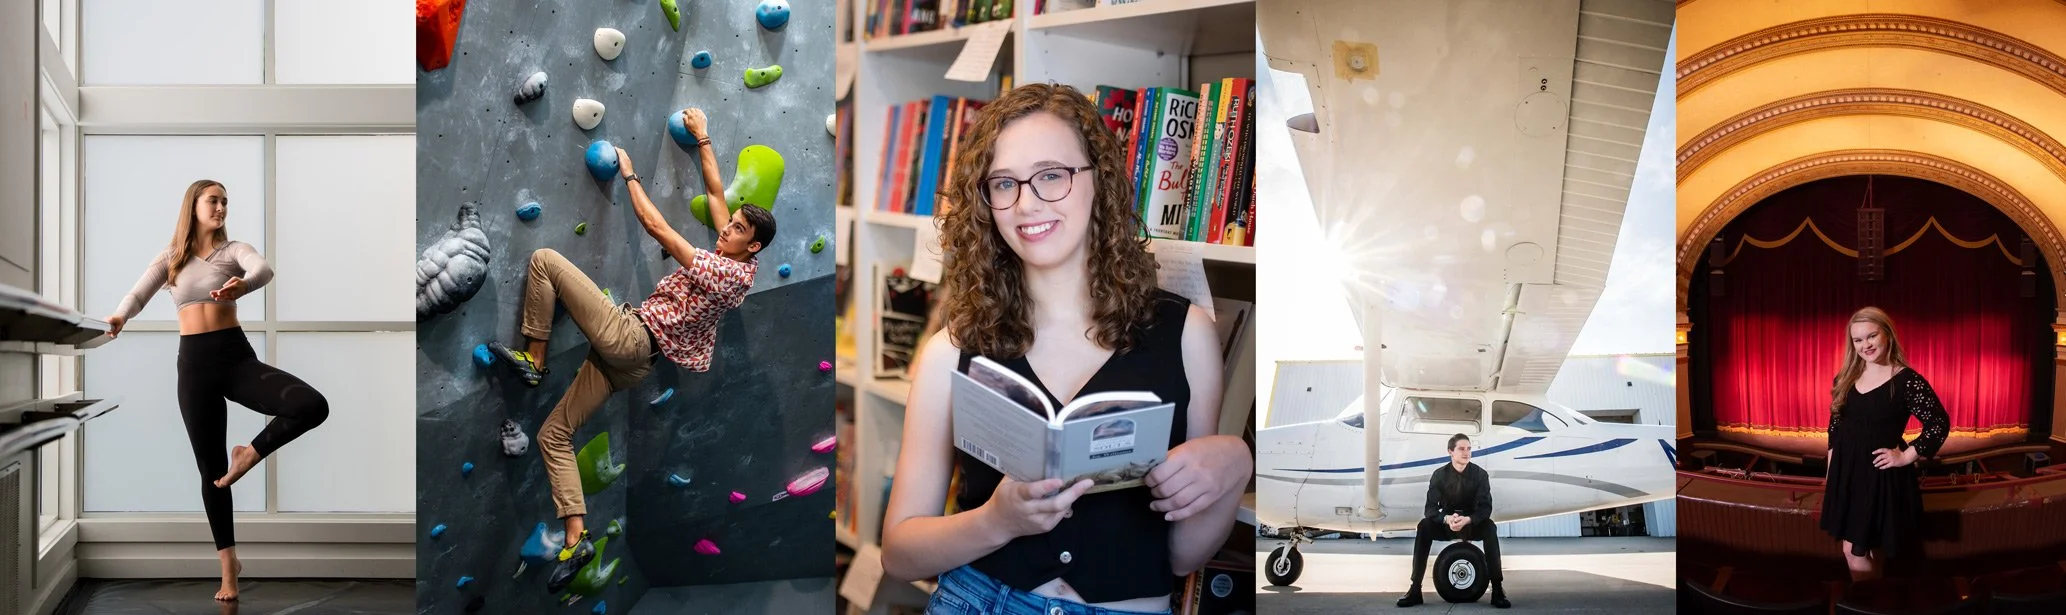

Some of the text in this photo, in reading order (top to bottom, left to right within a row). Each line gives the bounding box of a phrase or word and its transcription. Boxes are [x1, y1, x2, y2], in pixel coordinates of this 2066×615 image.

[1225, 98, 1239, 162] RUTH OZEKI
[1171, 161, 1184, 170] The
[1159, 168, 1188, 191] Bul
